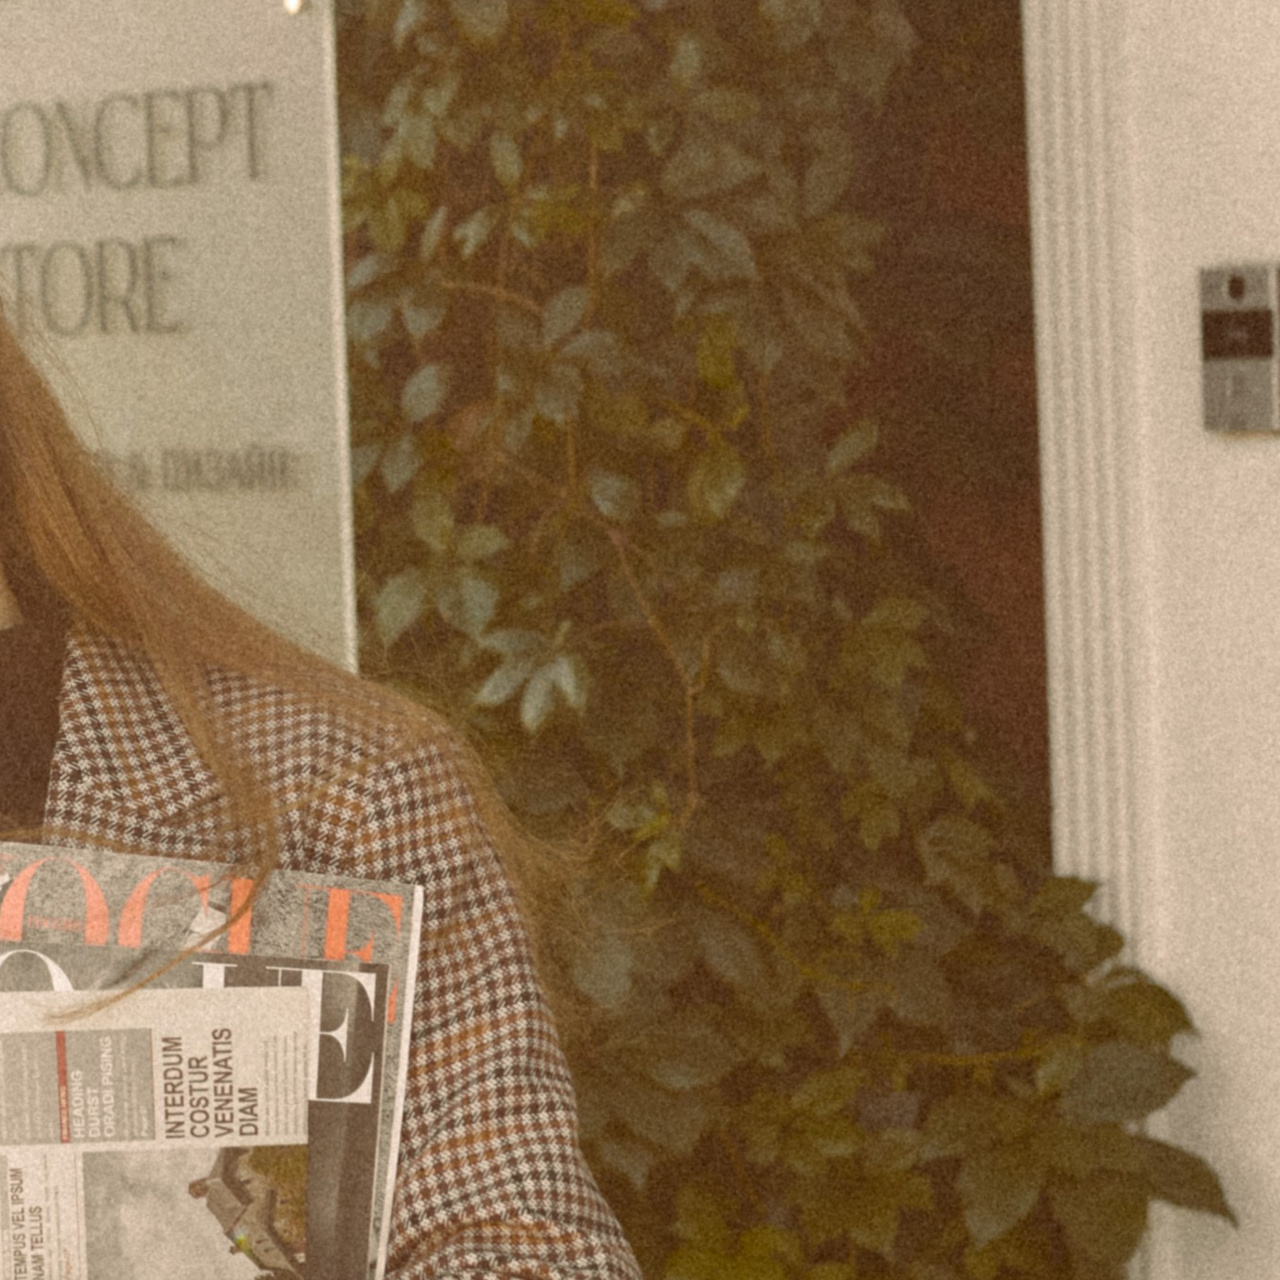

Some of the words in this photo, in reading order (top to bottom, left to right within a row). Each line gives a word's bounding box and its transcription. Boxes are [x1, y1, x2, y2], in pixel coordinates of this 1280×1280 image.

[100, 1035, 113, 1086] PISING
[211, 1027, 234, 1139] VENENATIS
[71, 1069, 85, 1138] HEADING
[86, 1086, 100, 1138] DURST
[162, 1036, 185, 1139] INTERDUM
[187, 1056, 210, 1138] COSTUR
[238, 1087, 259, 1137] DIAM
[9, 1167, 25, 1204] IPSUM
[11, 1207, 26, 1231] VEL
[28, 1205, 44, 1250] TELLUS
